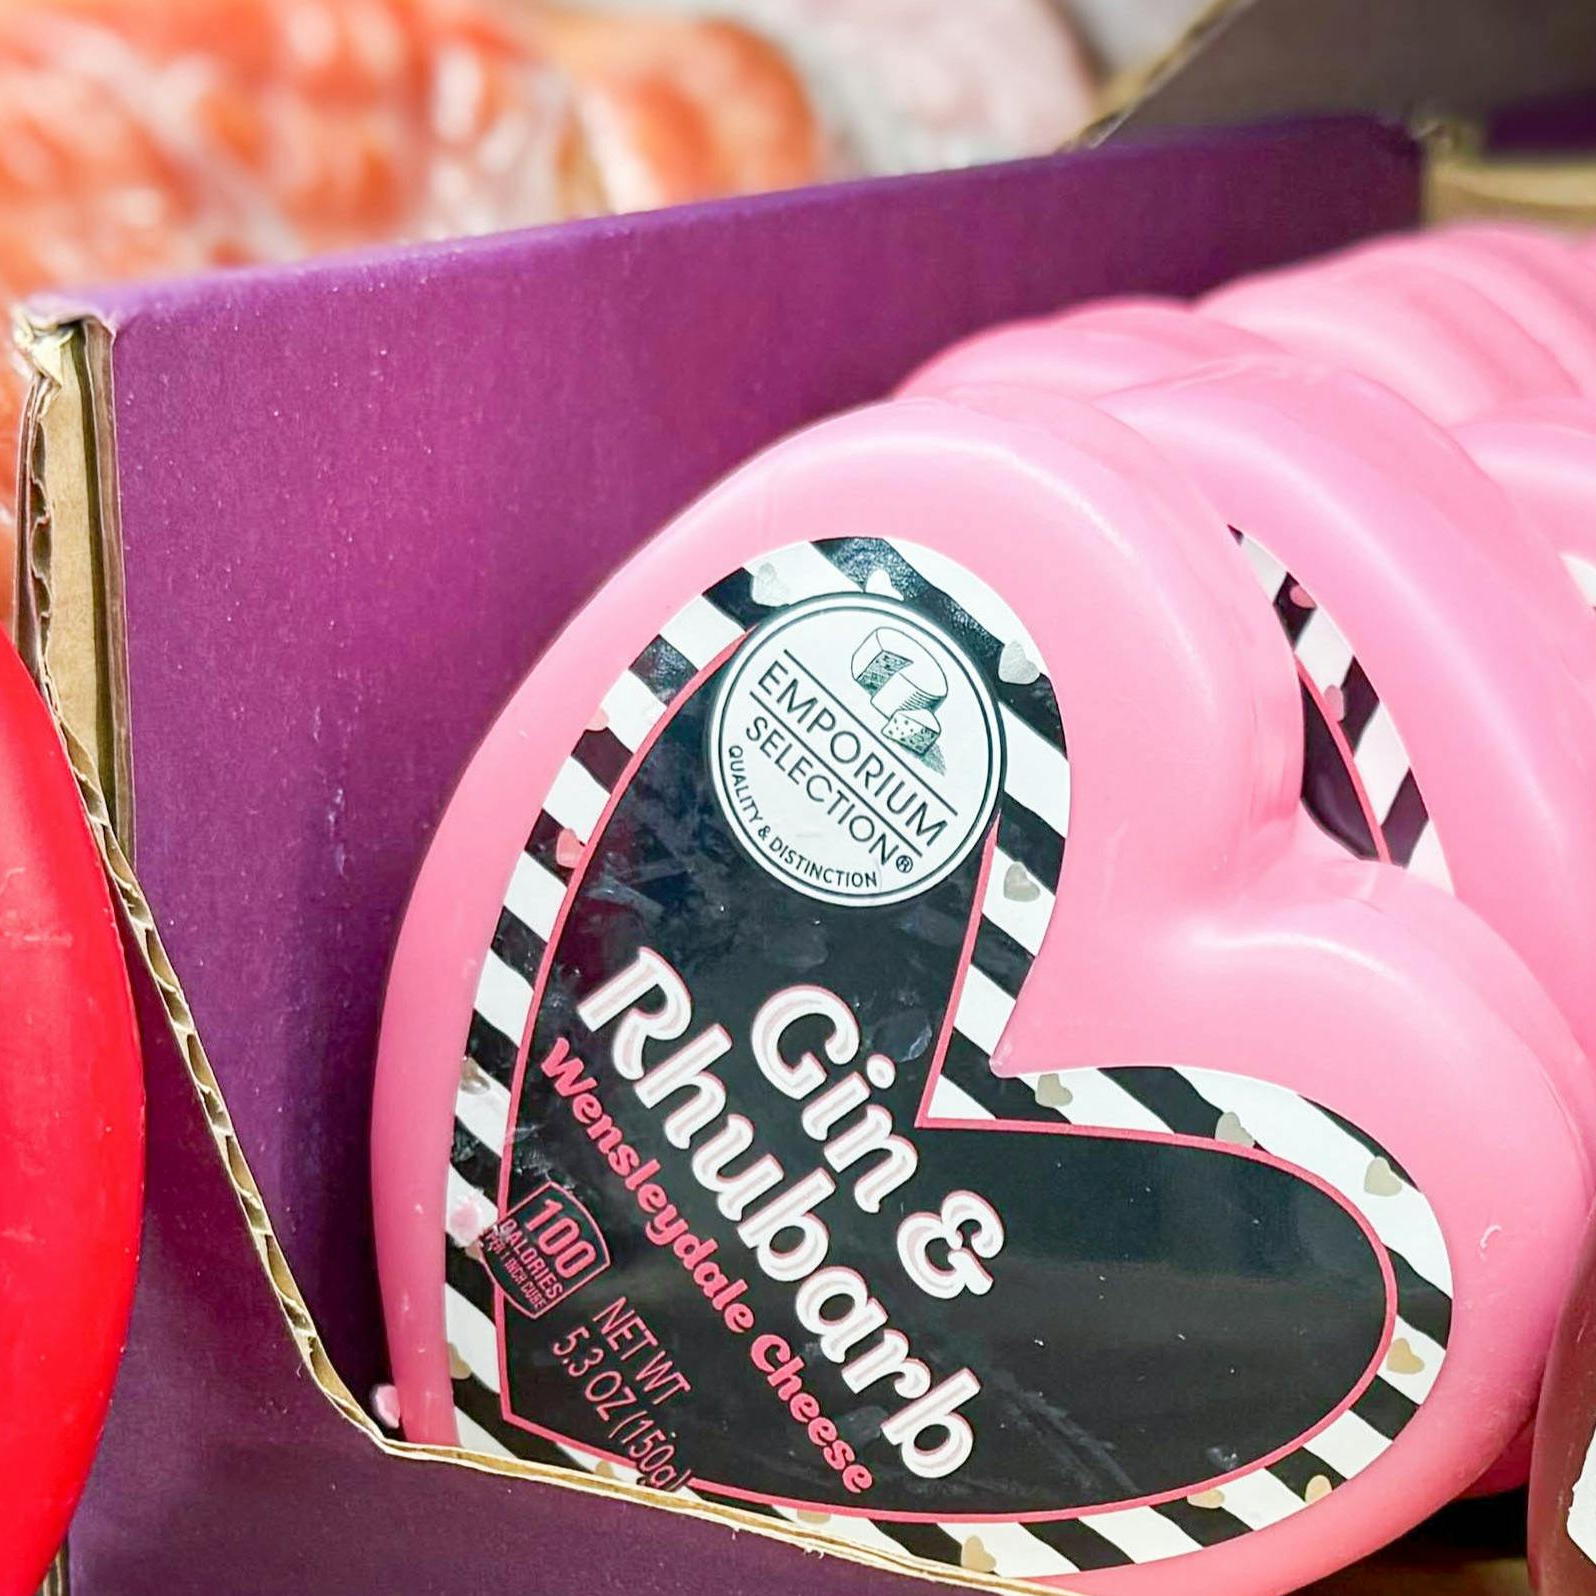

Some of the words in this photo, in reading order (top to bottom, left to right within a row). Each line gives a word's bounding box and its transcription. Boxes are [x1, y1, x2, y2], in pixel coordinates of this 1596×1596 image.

[728, 745, 762, 824] QUALITY
[758, 824, 772, 839] &
[769, 835, 878, 888] DISTINCTION
[756, 660, 949, 847] EMPORIUM
[576, 946, 982, 1479] Rhubarb
[750, 984, 918, 1214] Gin
[896, 1190, 1004, 1299] &
[499, 1218, 565, 1300] CALORIES
[525, 1198, 597, 1279] 100
[539, 1037, 755, 1334] Wensleydale
[751, 1333, 874, 1494] Cheese
[552, 1326, 604, 1378] 5.3
[584, 1370, 638, 1422] OZ
[591, 1296, 660, 1361] NET
[635, 1350, 693, 1406] WT
